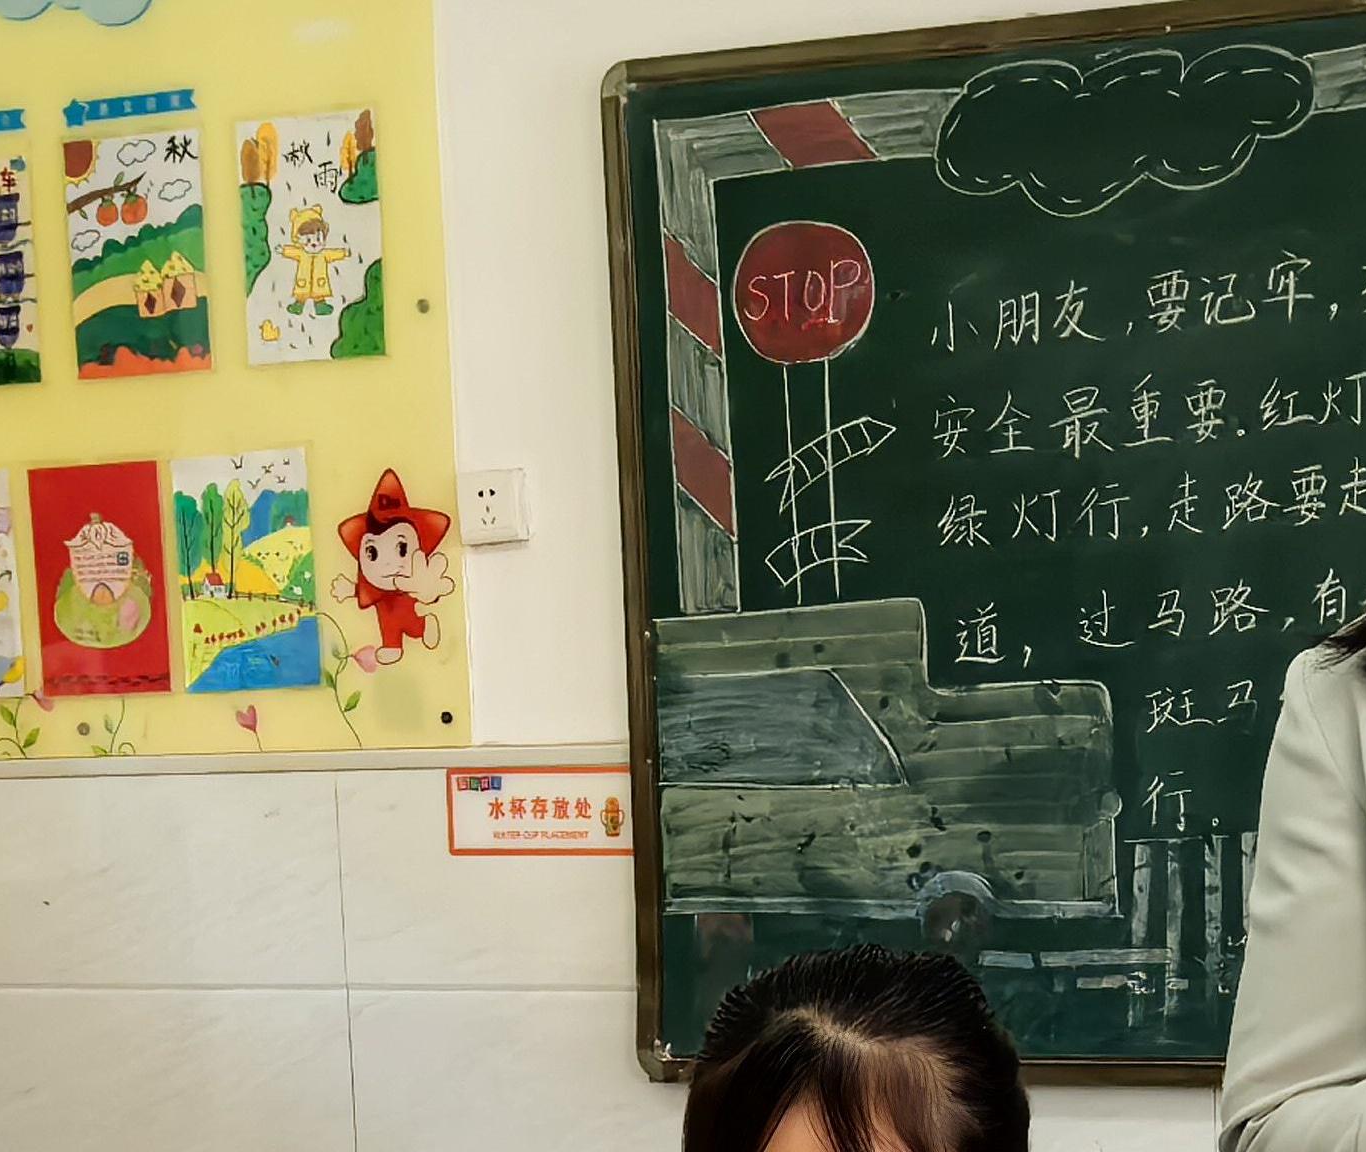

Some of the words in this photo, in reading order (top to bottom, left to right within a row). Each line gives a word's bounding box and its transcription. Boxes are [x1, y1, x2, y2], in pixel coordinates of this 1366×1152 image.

[164, 135, 198, 164] 秋
[745, 258, 869, 325] STOP
[488, 796, 592, 820] 水杯存放处
